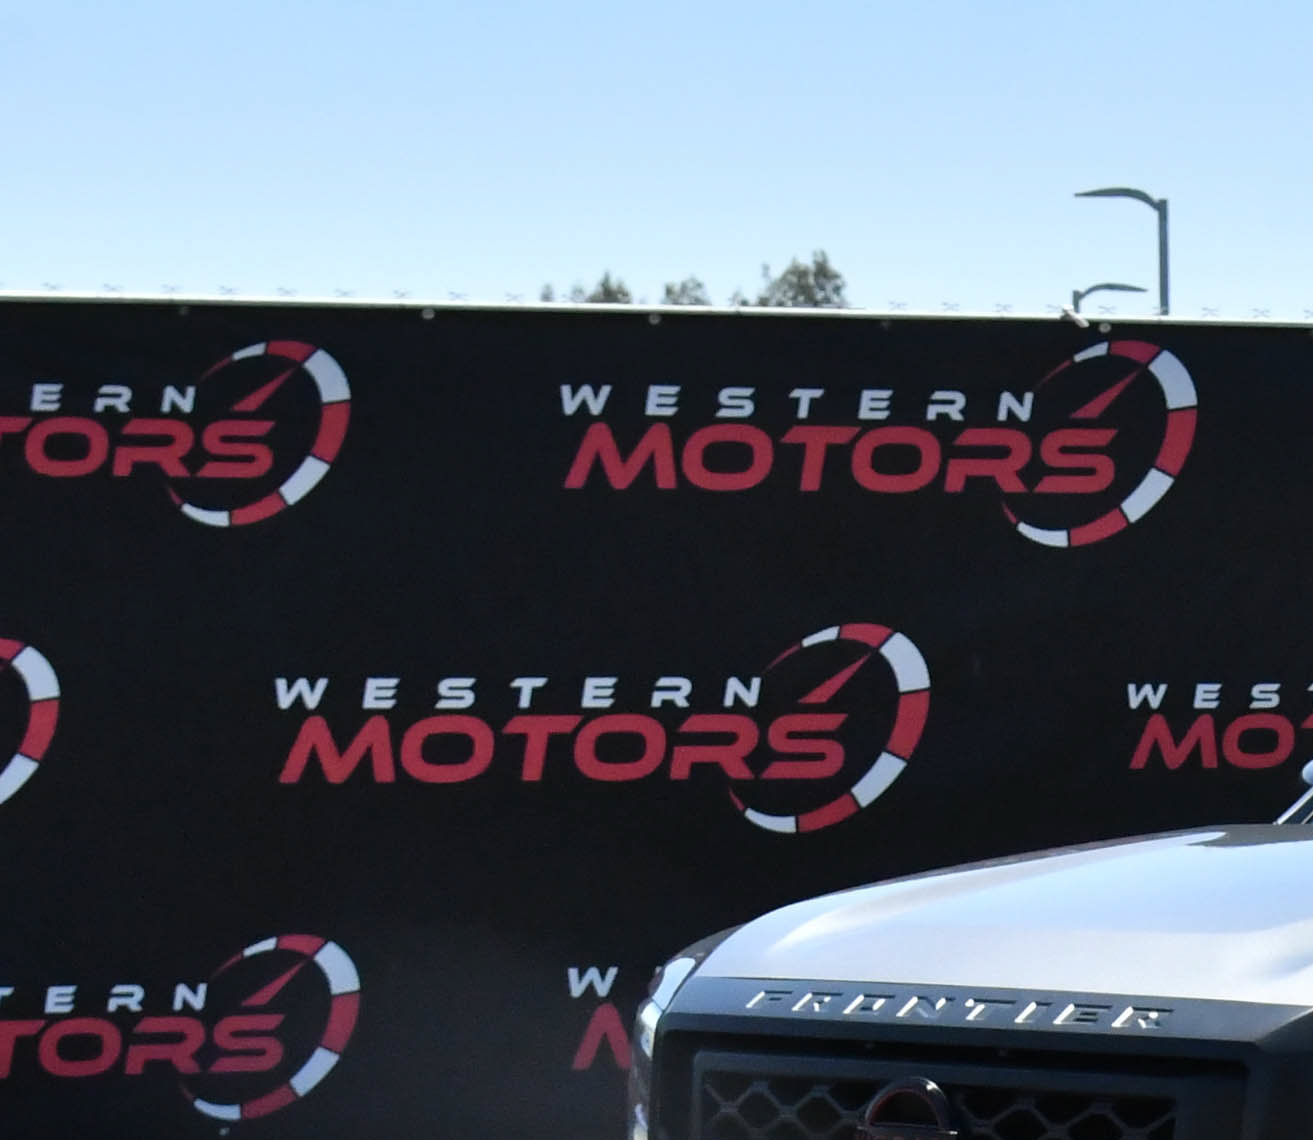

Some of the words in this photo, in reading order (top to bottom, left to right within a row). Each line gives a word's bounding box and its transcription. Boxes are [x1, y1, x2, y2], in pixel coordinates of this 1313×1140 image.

[29, 383, 196, 413] ERN
[560, 384, 1035, 422] WESTERN
[563, 423, 1119, 494] MOTORS
[275, 677, 762, 709] WESTERN
[279, 714, 849, 784] MOTORS
[745, 989, 1176, 1029] FRONTIER
